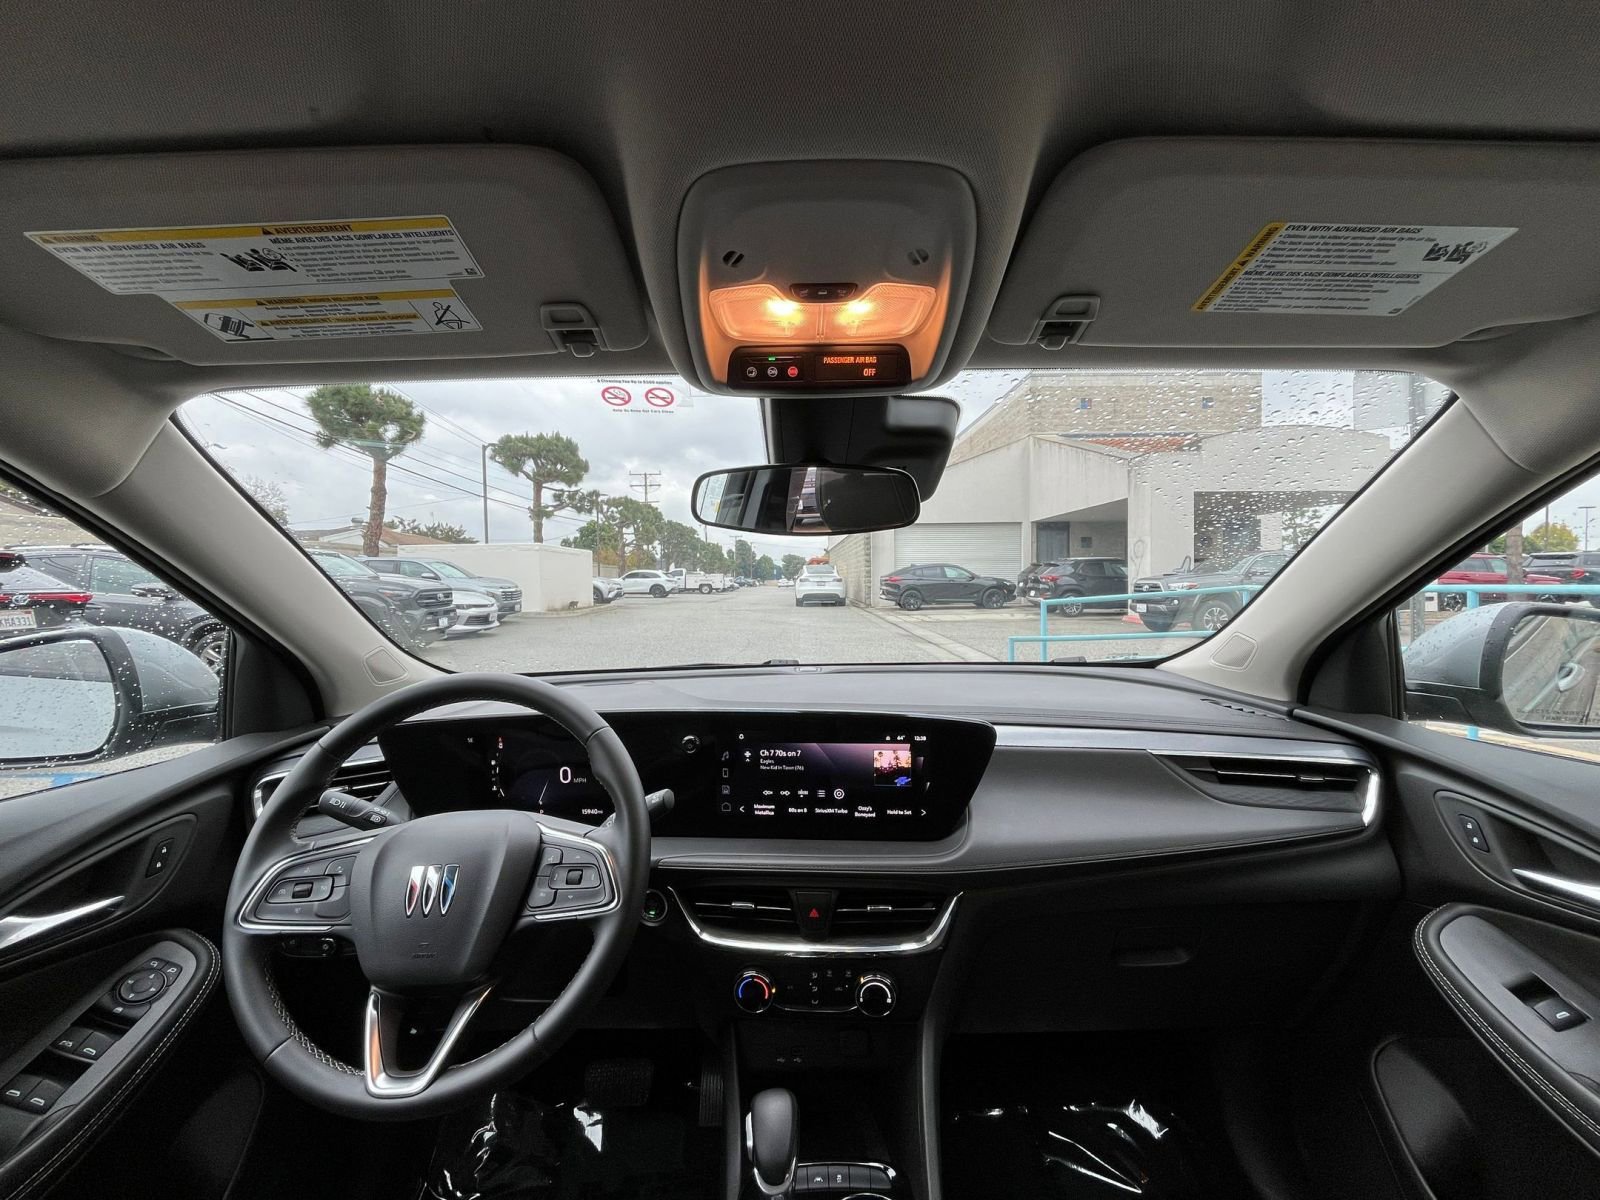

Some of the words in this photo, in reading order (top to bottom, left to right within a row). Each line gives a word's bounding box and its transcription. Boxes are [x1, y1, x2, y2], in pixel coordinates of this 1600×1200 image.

[403, 230, 454, 238] INTELLIGENTS
[823, 356, 855, 364] PASSENGER
[855, 356, 865, 364] AIR
[865, 356, 877, 364] BAG
[863, 368, 877, 377] OFF
[760, 749, 770, 757] Ch
[559, 766, 572, 784] 0
